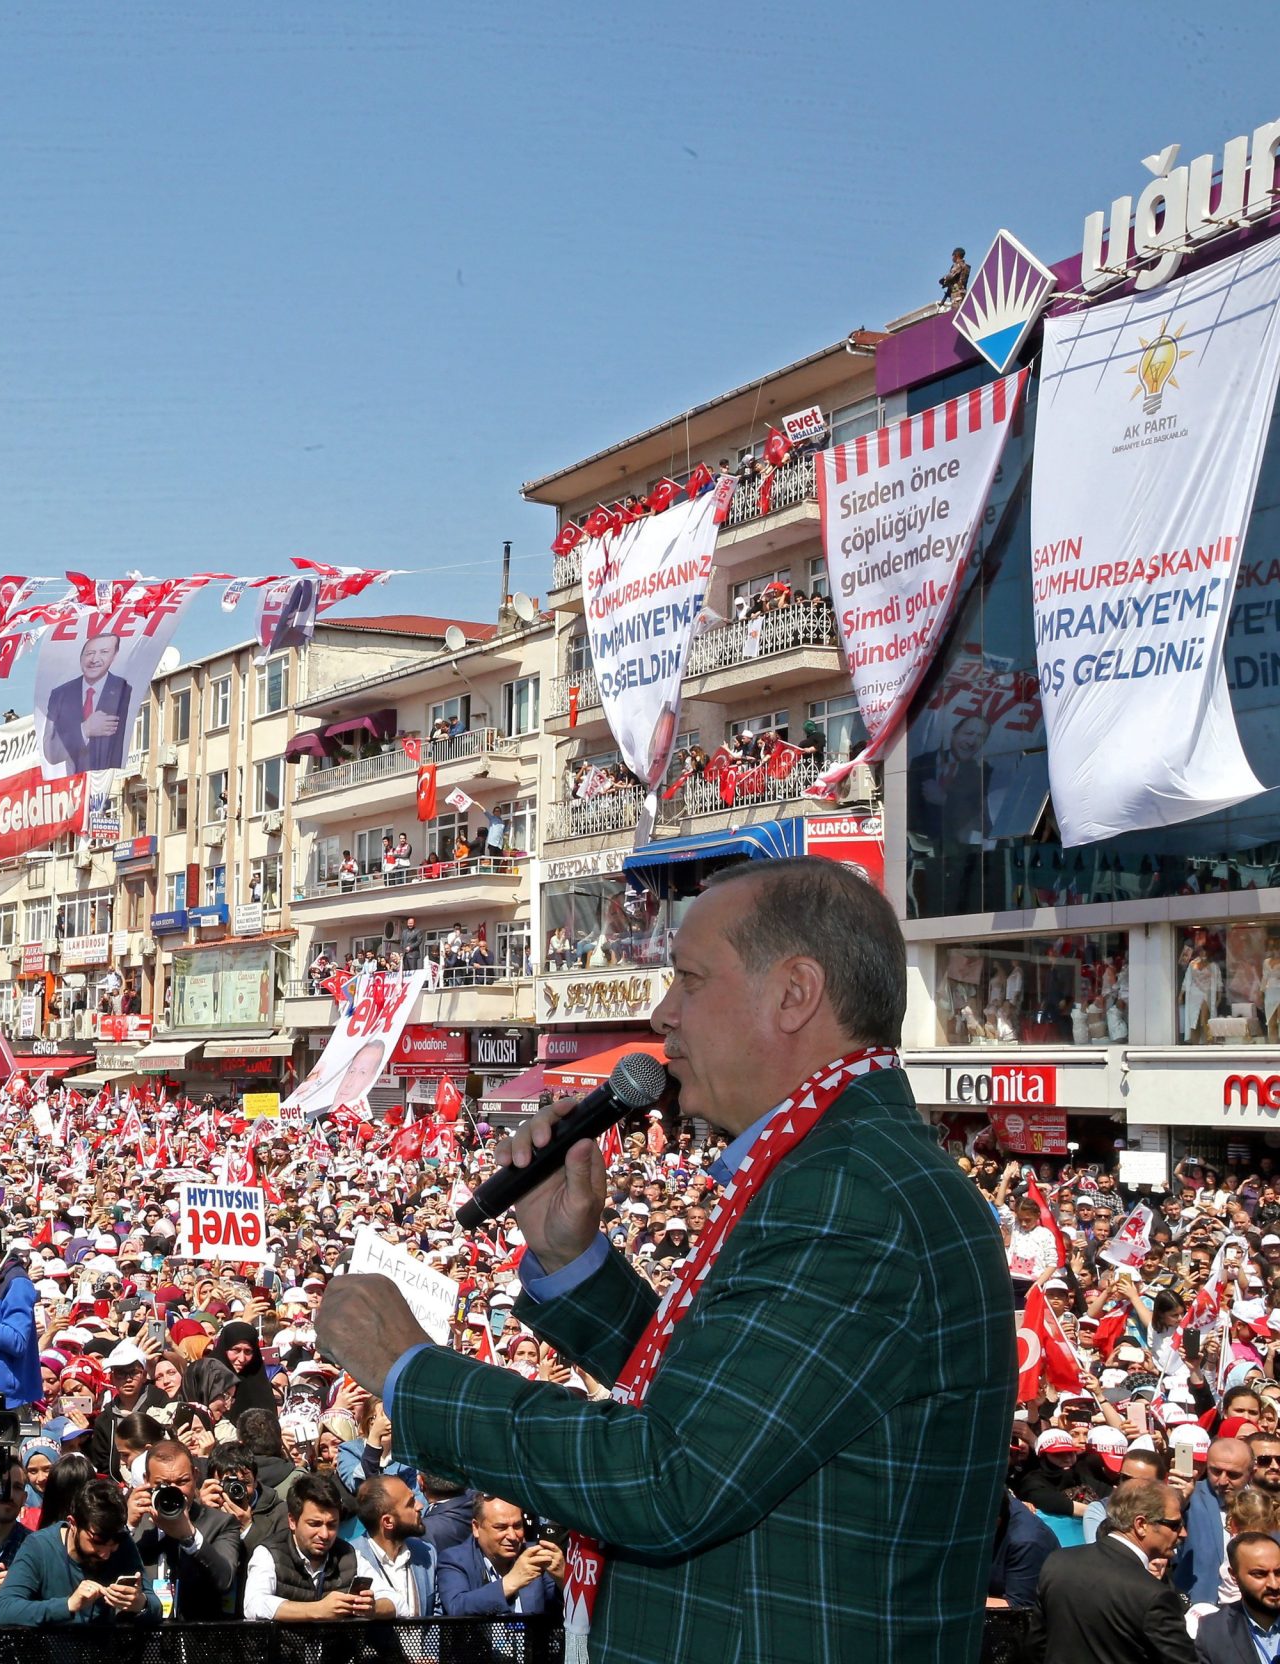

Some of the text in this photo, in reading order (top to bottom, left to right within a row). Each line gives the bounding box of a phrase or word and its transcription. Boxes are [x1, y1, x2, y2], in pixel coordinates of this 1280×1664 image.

[787, 408, 821, 433] evet
[1123, 415, 1177, 441] AK PARTİ
[840, 458, 961, 520] Sizden önce
[841, 496, 950, 559] çöplüğüyle
[1033, 536, 1083, 573] SAYIN
[51, 606, 178, 641] EVET
[842, 594, 901, 639] Şimdi
[96, 831, 107, 839] KAT
[808, 818, 858, 836] KUAFÖR
[413, 1037, 448, 1051] vodafone
[478, 1039, 517, 1063] KOKOSH
[548, 1040, 578, 1054] OLGUN
[945, 1067, 1045, 1105] Leonita
[280, 1104, 303, 1119] evet
[482, 1102, 502, 1112] OLGUN
[187, 1187, 259, 1210] İNŞALLAH
[188, 1209, 261, 1254] evet
